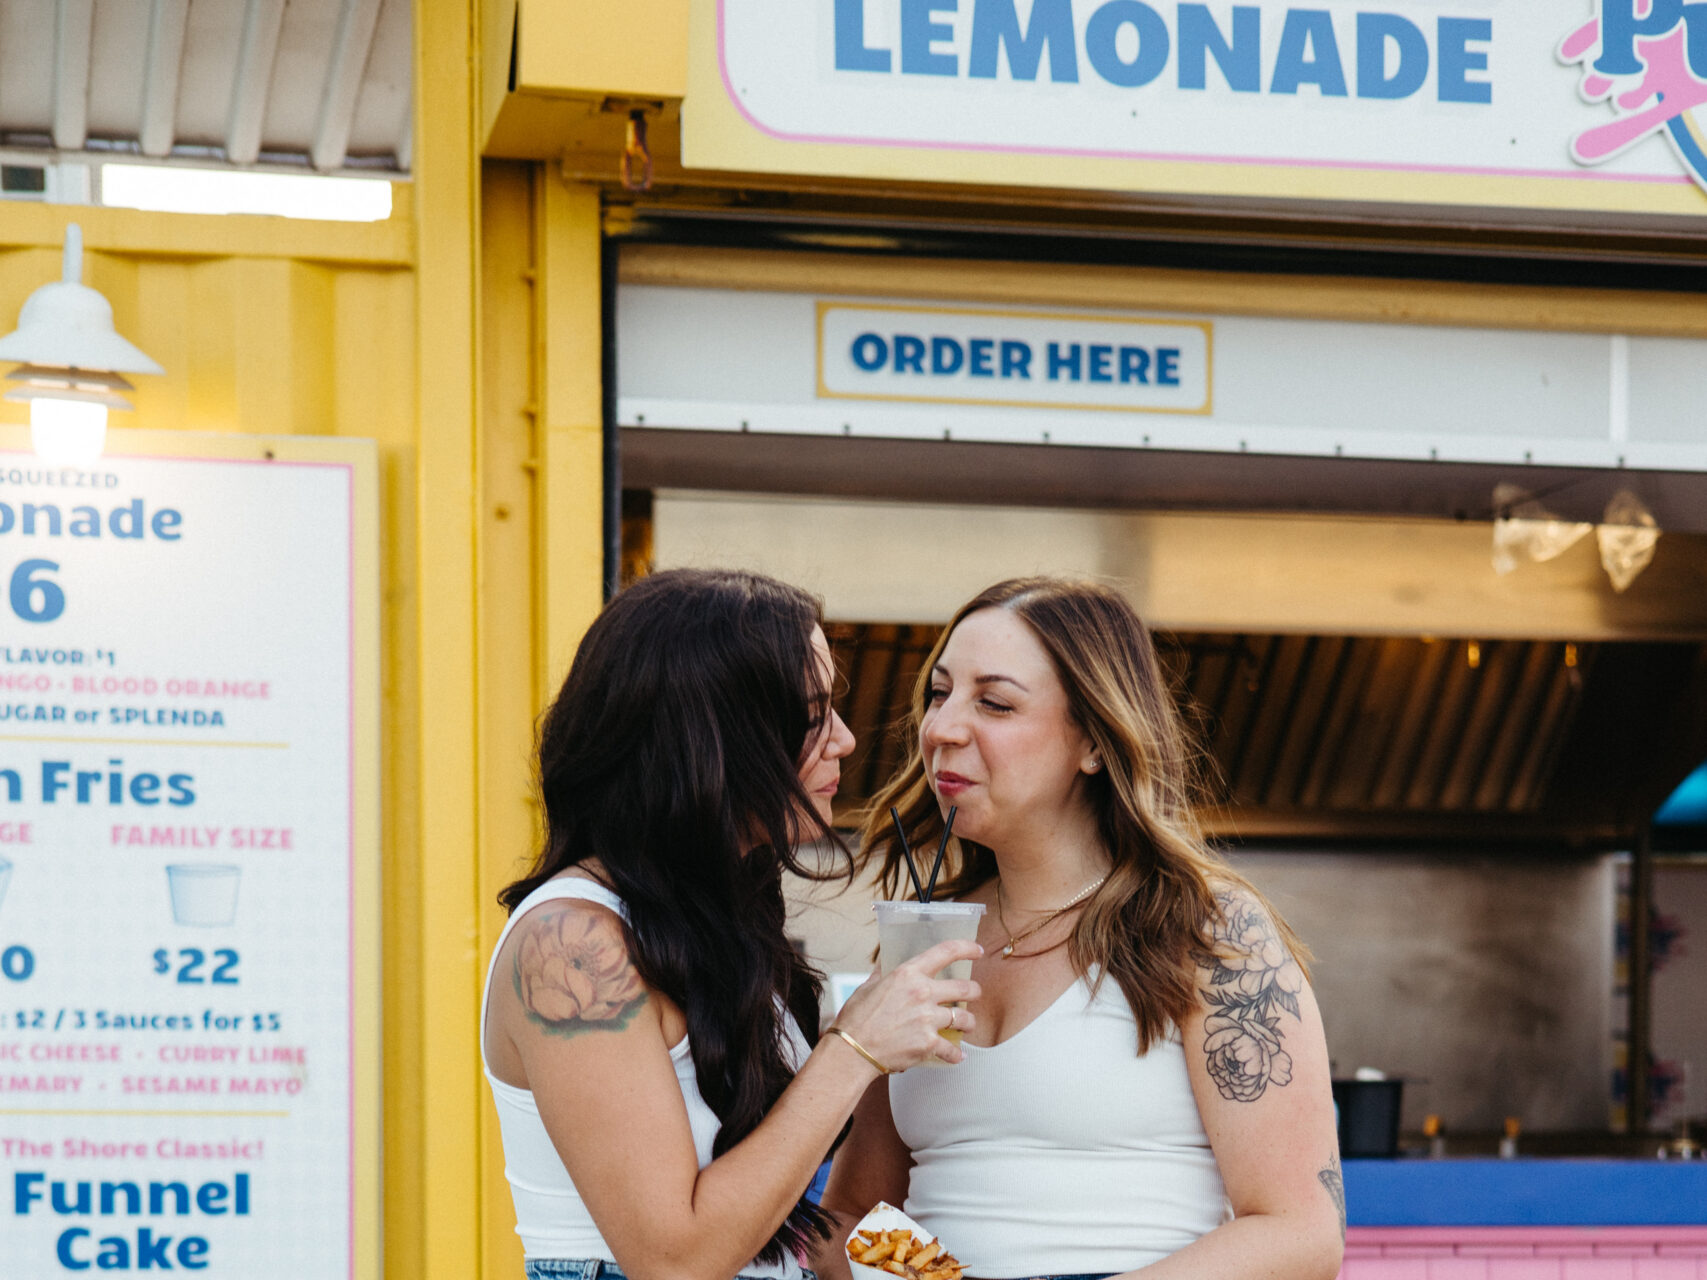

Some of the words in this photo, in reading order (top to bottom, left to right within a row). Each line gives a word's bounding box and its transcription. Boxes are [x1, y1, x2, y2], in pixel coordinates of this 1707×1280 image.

[834, 0, 1492, 104] LEMONADE
[851, 333, 1032, 379] ORDER
[1047, 343, 1180, 386] HERE
[72, 676, 158, 695] BLOOD
[166, 679, 269, 699] ORANGE
[74, 710, 99, 723] or
[110, 708, 224, 726] SPLENDA
[42, 759, 196, 807] Fries
[112, 825, 220, 847] FAMILY
[231, 828, 291, 849] SIZE
[153, 948, 239, 984] $22
[16, 1010, 45, 1028] $2
[75, 1011, 86, 1028] 3
[96, 1011, 193, 1030] Sauces
[202, 1010, 242, 1030] for
[252, 1013, 280, 1032] $5
[30, 1045, 119, 1061] CHEESE
[159, 1046, 240, 1062] CURRY
[249, 1047, 305, 1066] LIME
[0, 1076, 81, 1091] MARY
[122, 1077, 219, 1093] SESAME
[229, 1076, 303, 1095] MAYO
[2, 1139, 53, 1157] The
[63, 1139, 147, 1158] Shore
[156, 1140, 263, 1159] Classic!
[15, 1172, 249, 1216] Funnel
[56, 1227, 209, 1271] Cake
